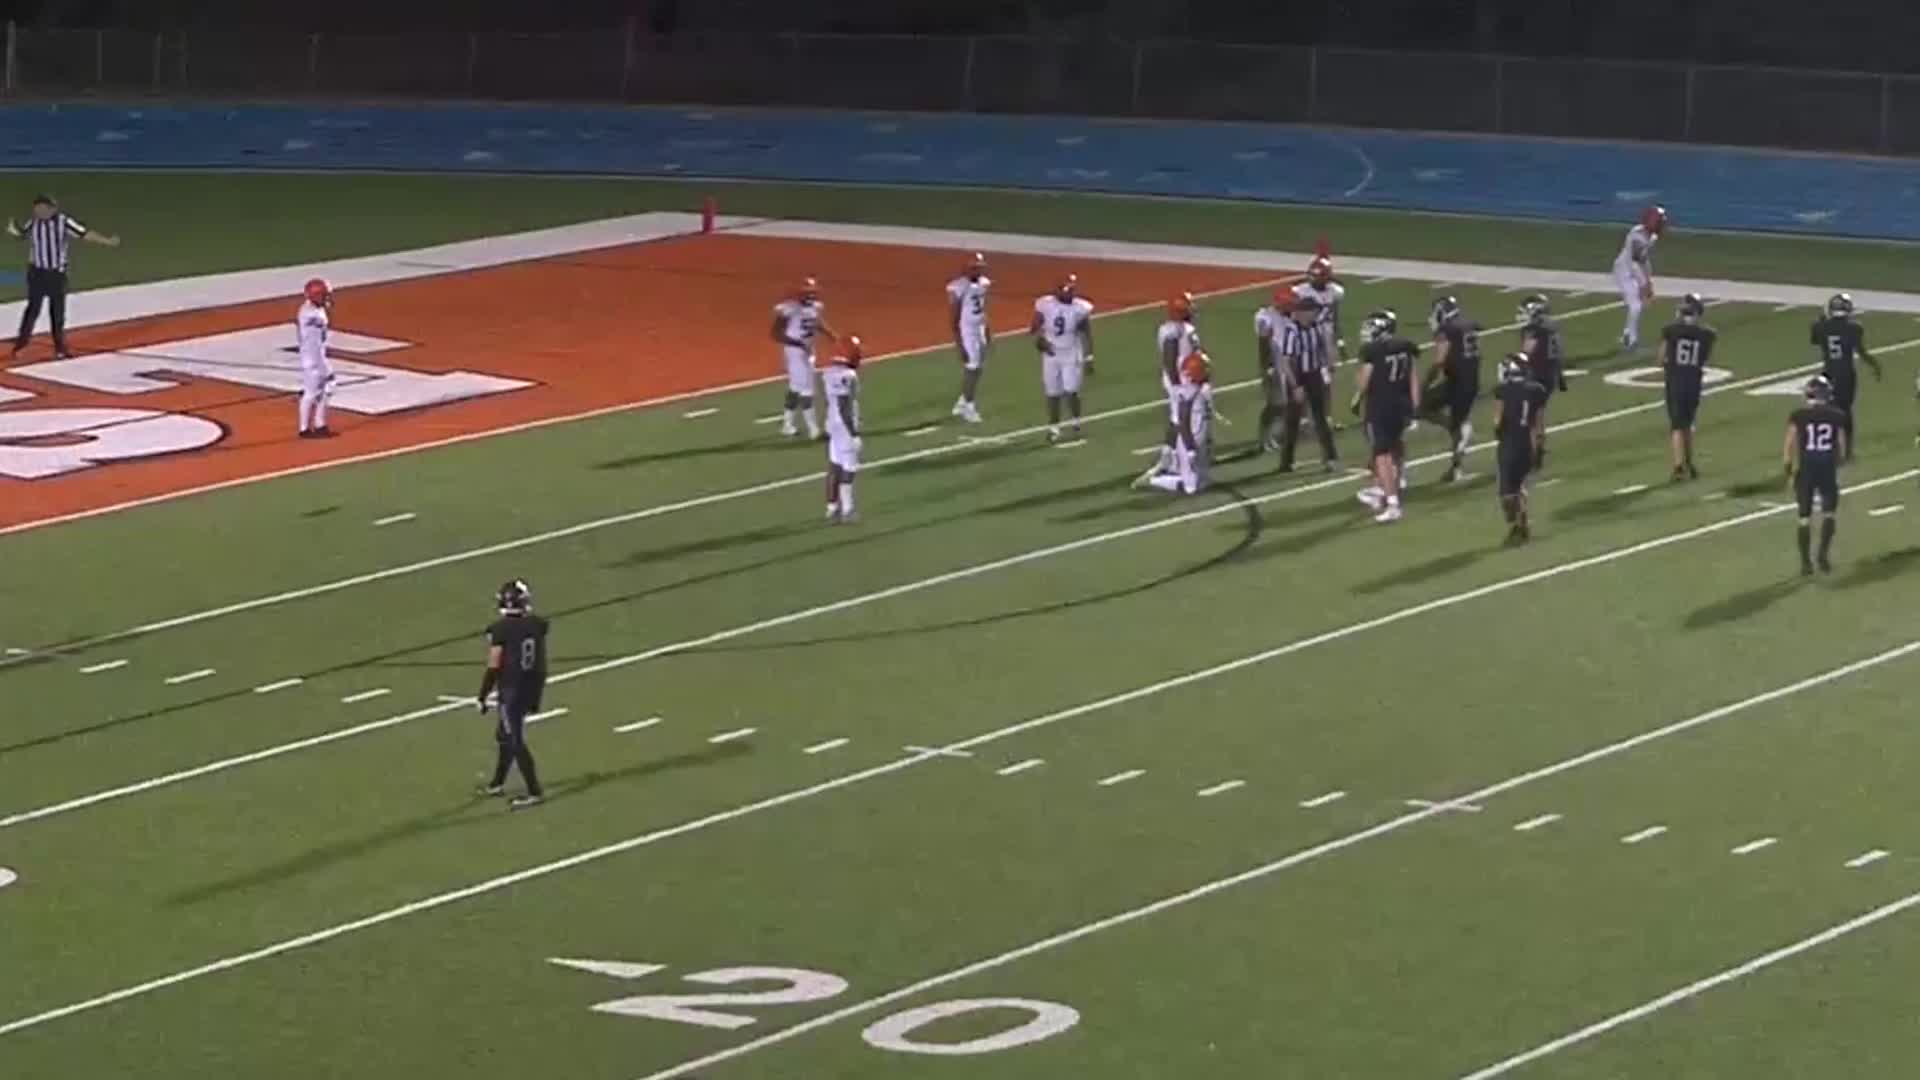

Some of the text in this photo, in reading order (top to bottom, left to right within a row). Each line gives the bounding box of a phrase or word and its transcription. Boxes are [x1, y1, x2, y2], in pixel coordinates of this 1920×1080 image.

[1054, 315, 1066, 337] 9
[1676, 338, 1700, 365] 61
[1828, 335, 1842, 359] 5
[1384, 352, 1409, 382] 77
[1805, 422, 1833, 451] 12
[521, 637, 536, 670] 8
[589, 966, 1081, 1055] 20
